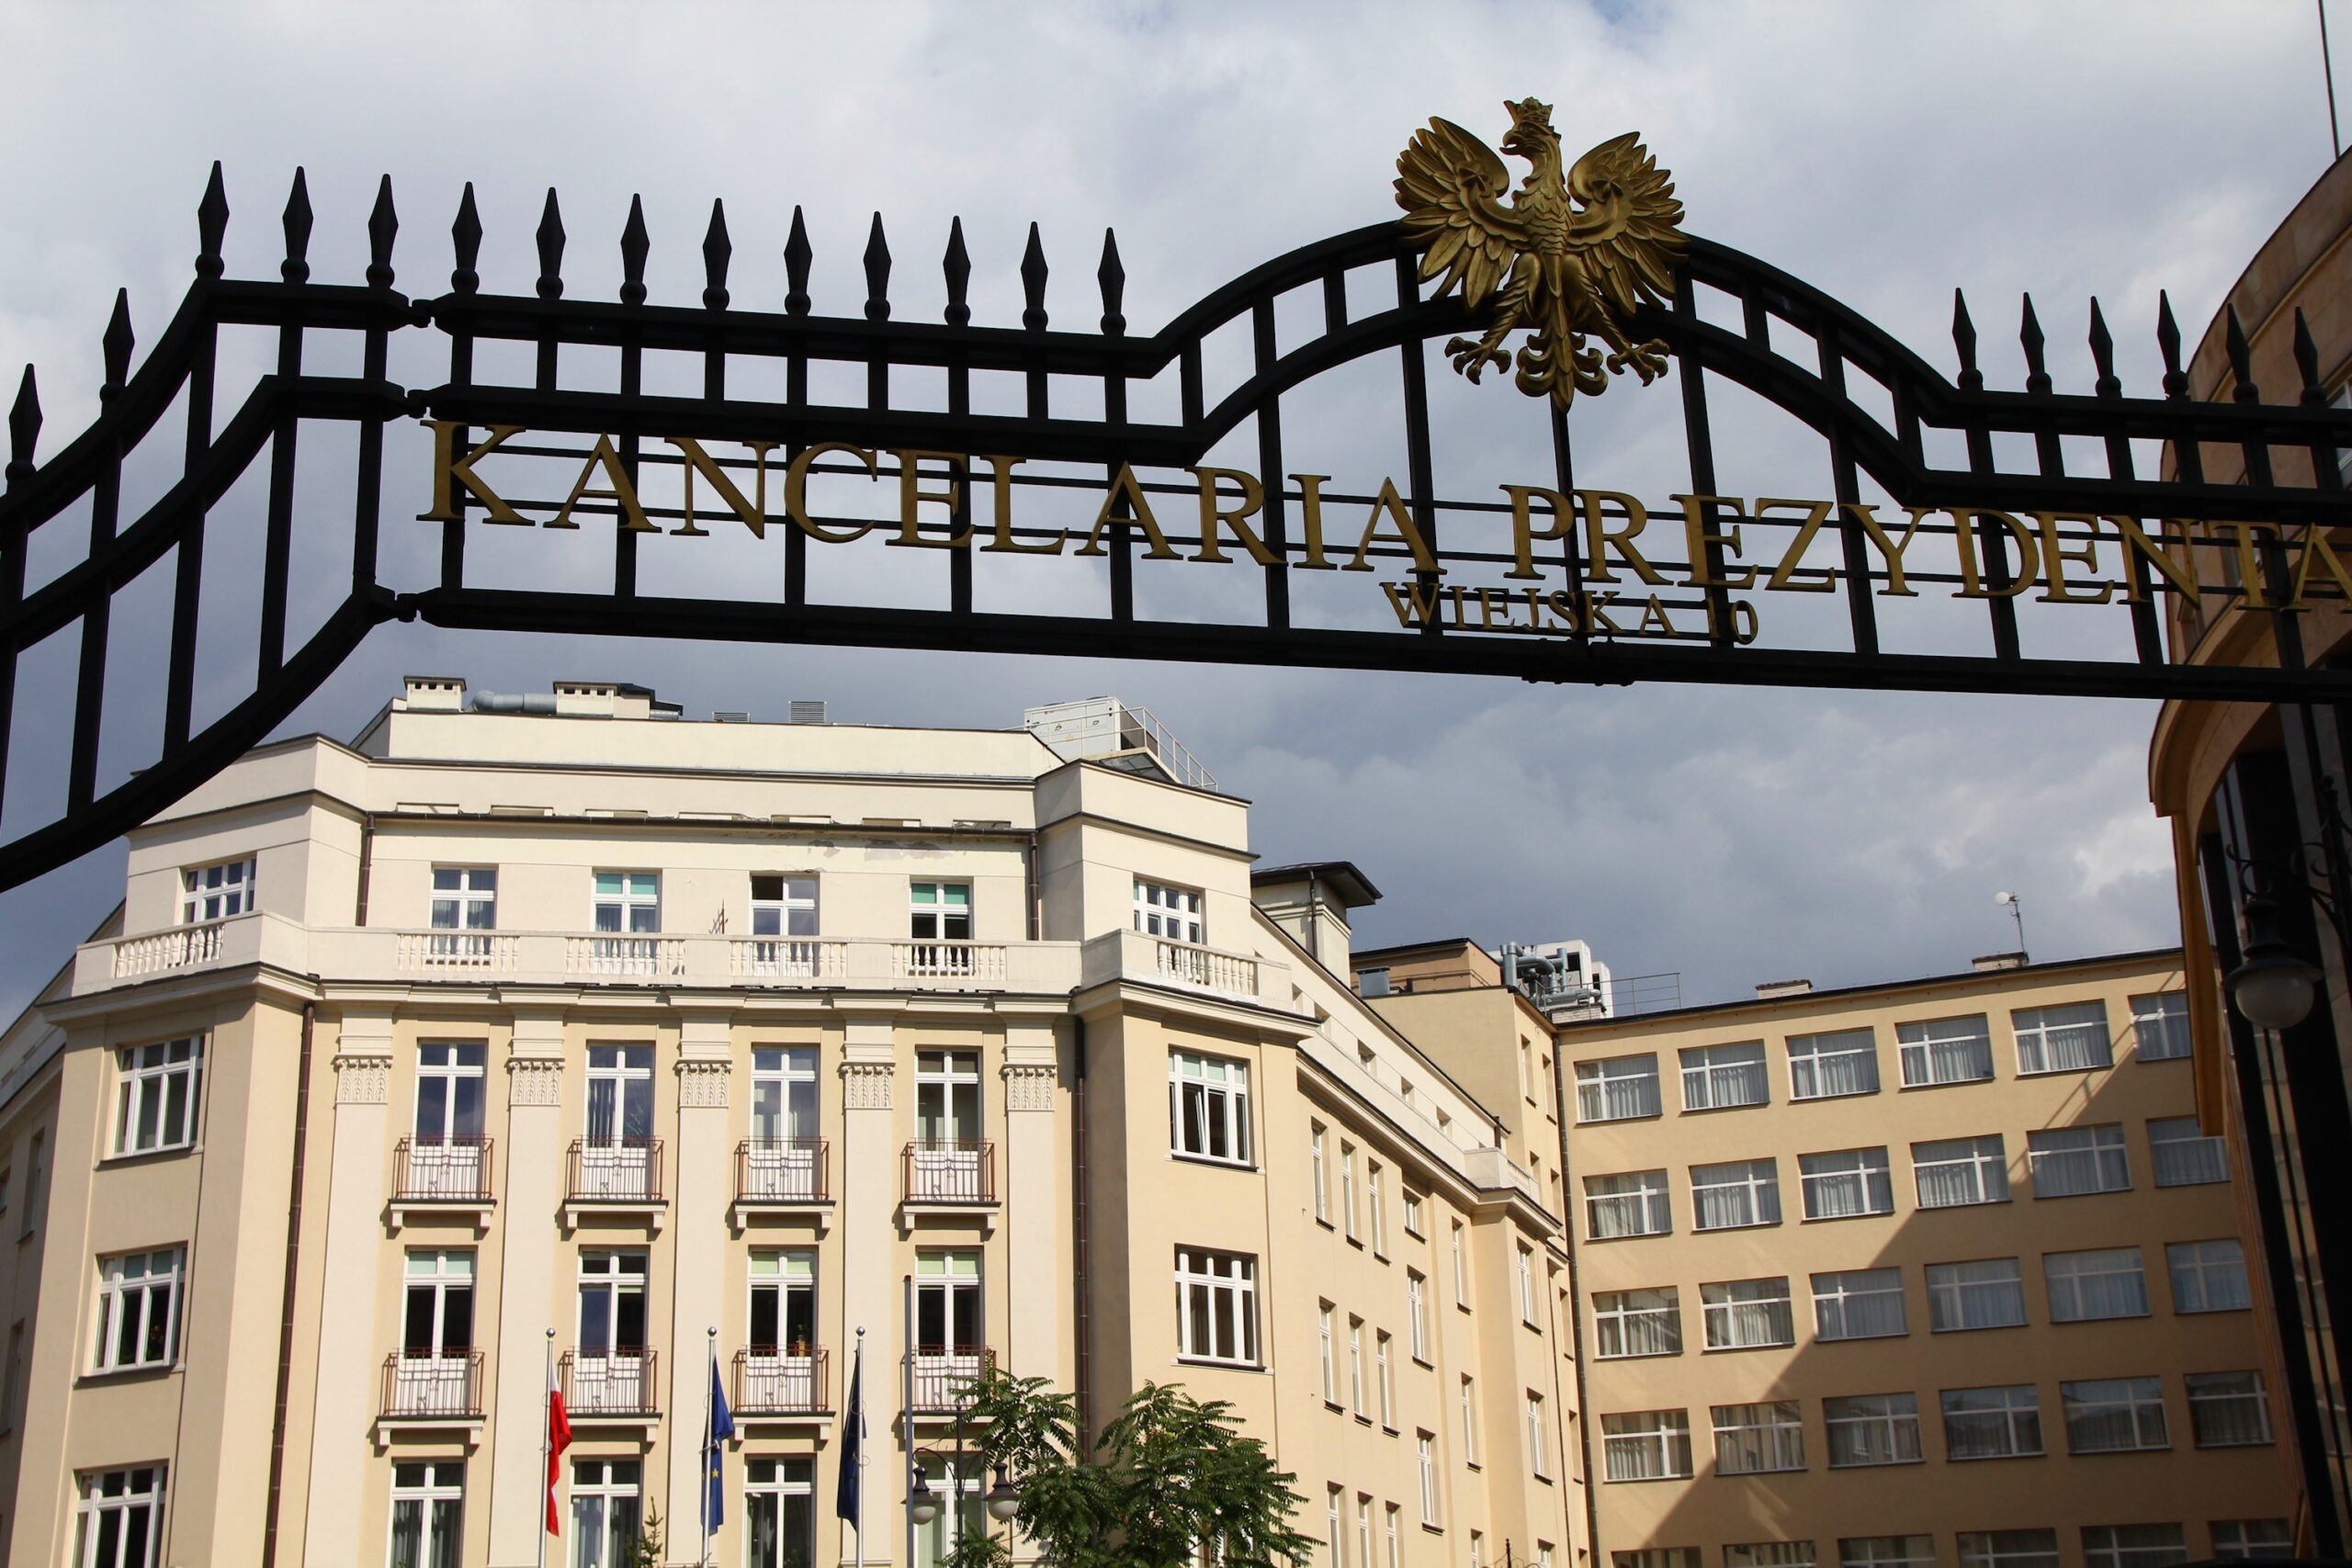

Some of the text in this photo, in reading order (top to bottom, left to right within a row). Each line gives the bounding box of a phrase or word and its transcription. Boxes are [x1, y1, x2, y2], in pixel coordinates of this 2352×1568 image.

[415, 419, 2352, 613] KANCELARIA PREZYDENTA
[1379, 581, 1758, 645] WIEJSKA 10
